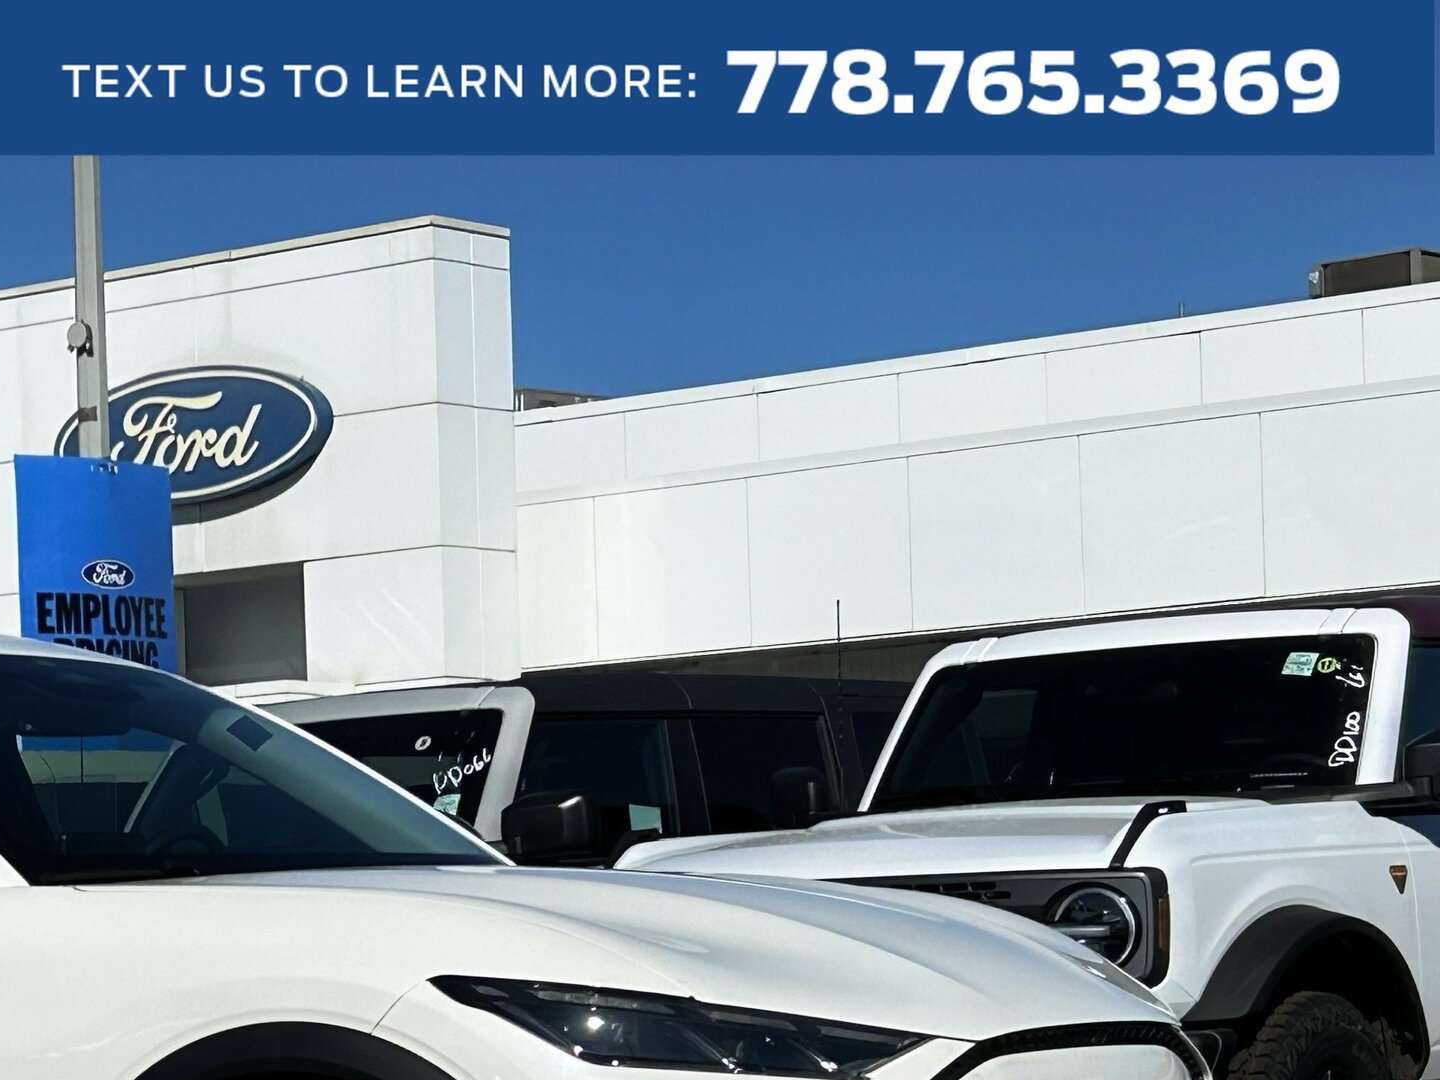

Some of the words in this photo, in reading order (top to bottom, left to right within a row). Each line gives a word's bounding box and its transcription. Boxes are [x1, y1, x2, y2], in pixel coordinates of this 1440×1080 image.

[110, 390, 263, 475] Ford
[92, 563, 126, 586] Ford
[36, 591, 168, 640] EMPLOYEE
